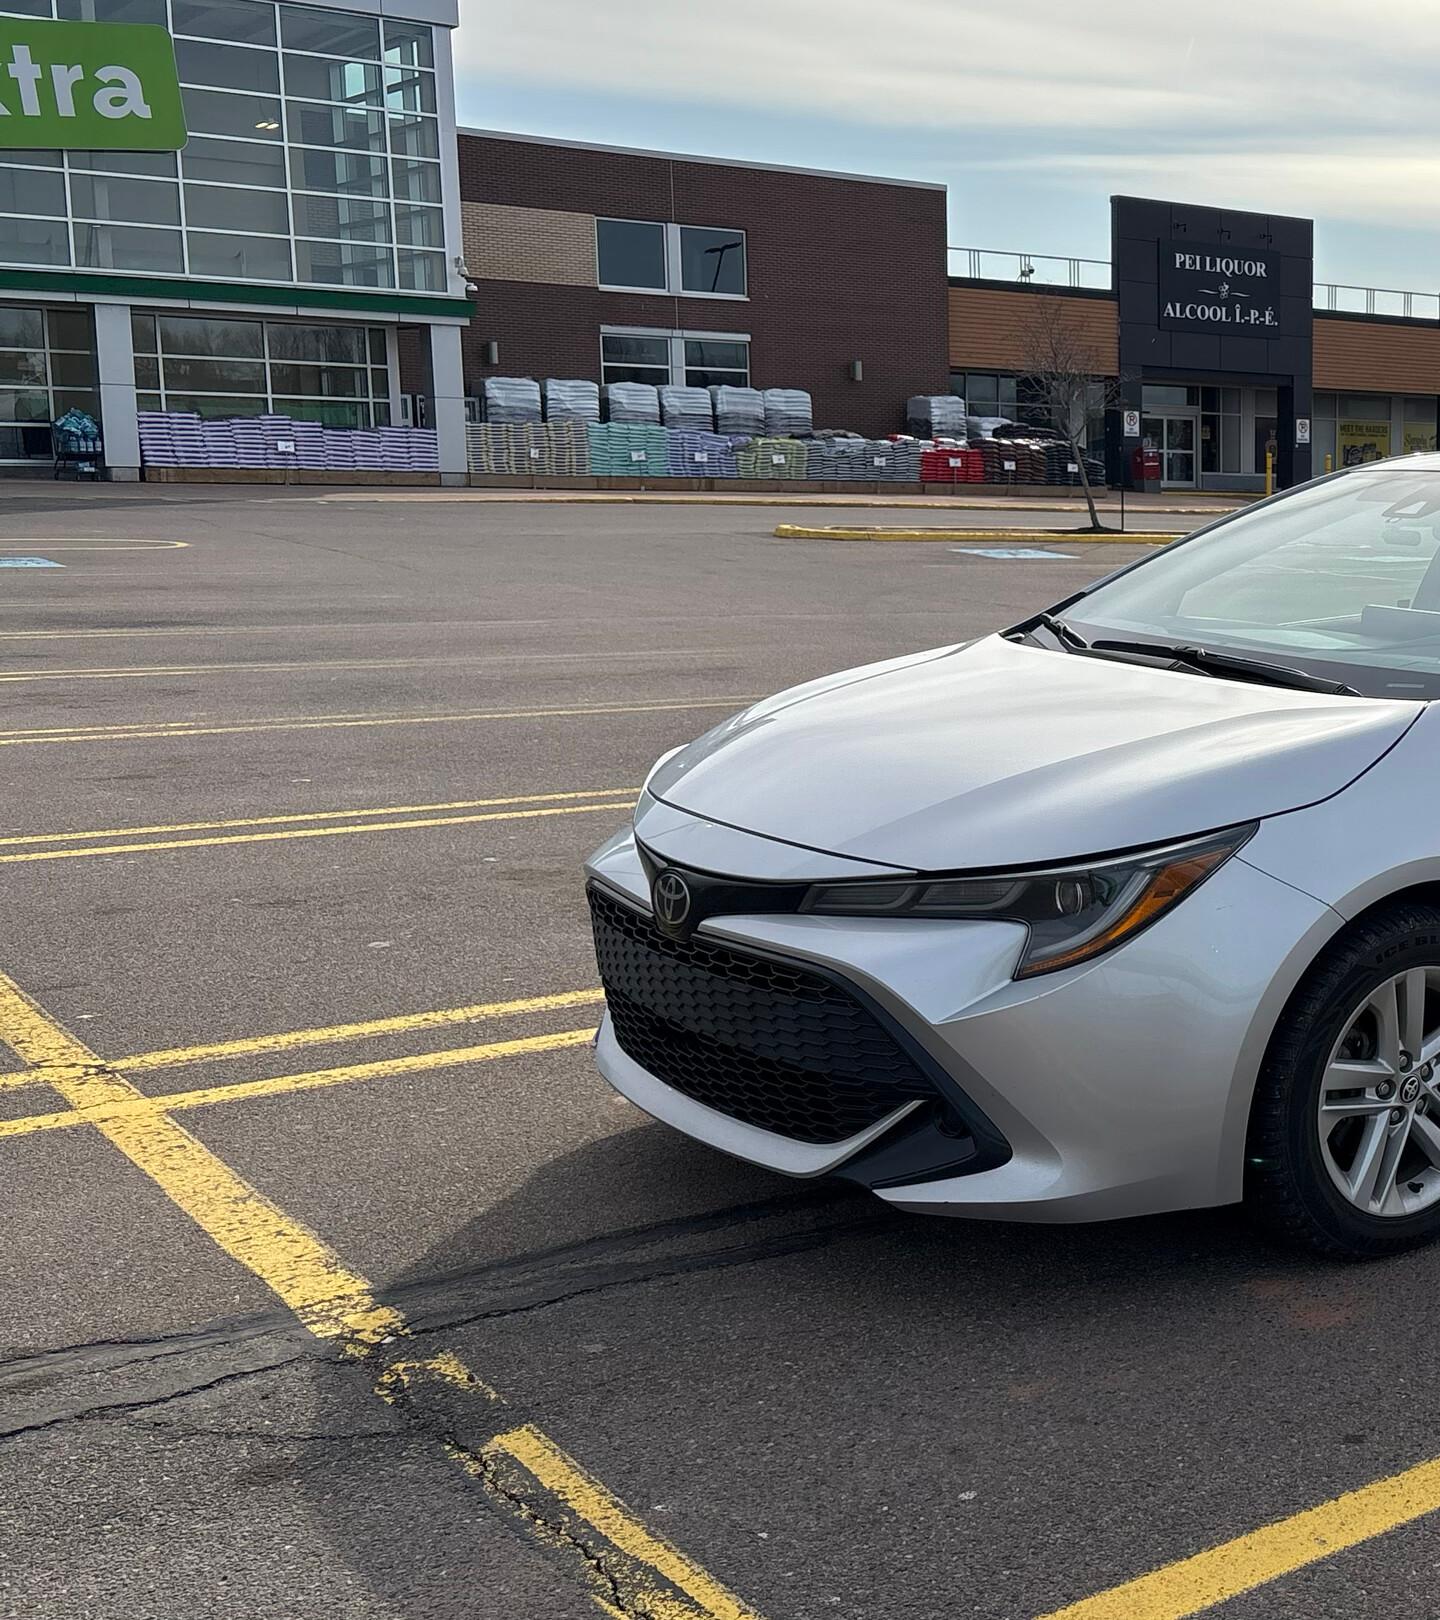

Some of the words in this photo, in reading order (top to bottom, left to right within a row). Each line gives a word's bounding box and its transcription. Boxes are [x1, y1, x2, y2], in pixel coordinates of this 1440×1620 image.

[0, 45, 152, 119] tra
[1175, 253, 1201, 271] PEI
[1205, 256, 1268, 278] LIQUOR
[1163, 302, 1231, 322] ALCOOL
[1375, 941, 1409, 964] ICE
